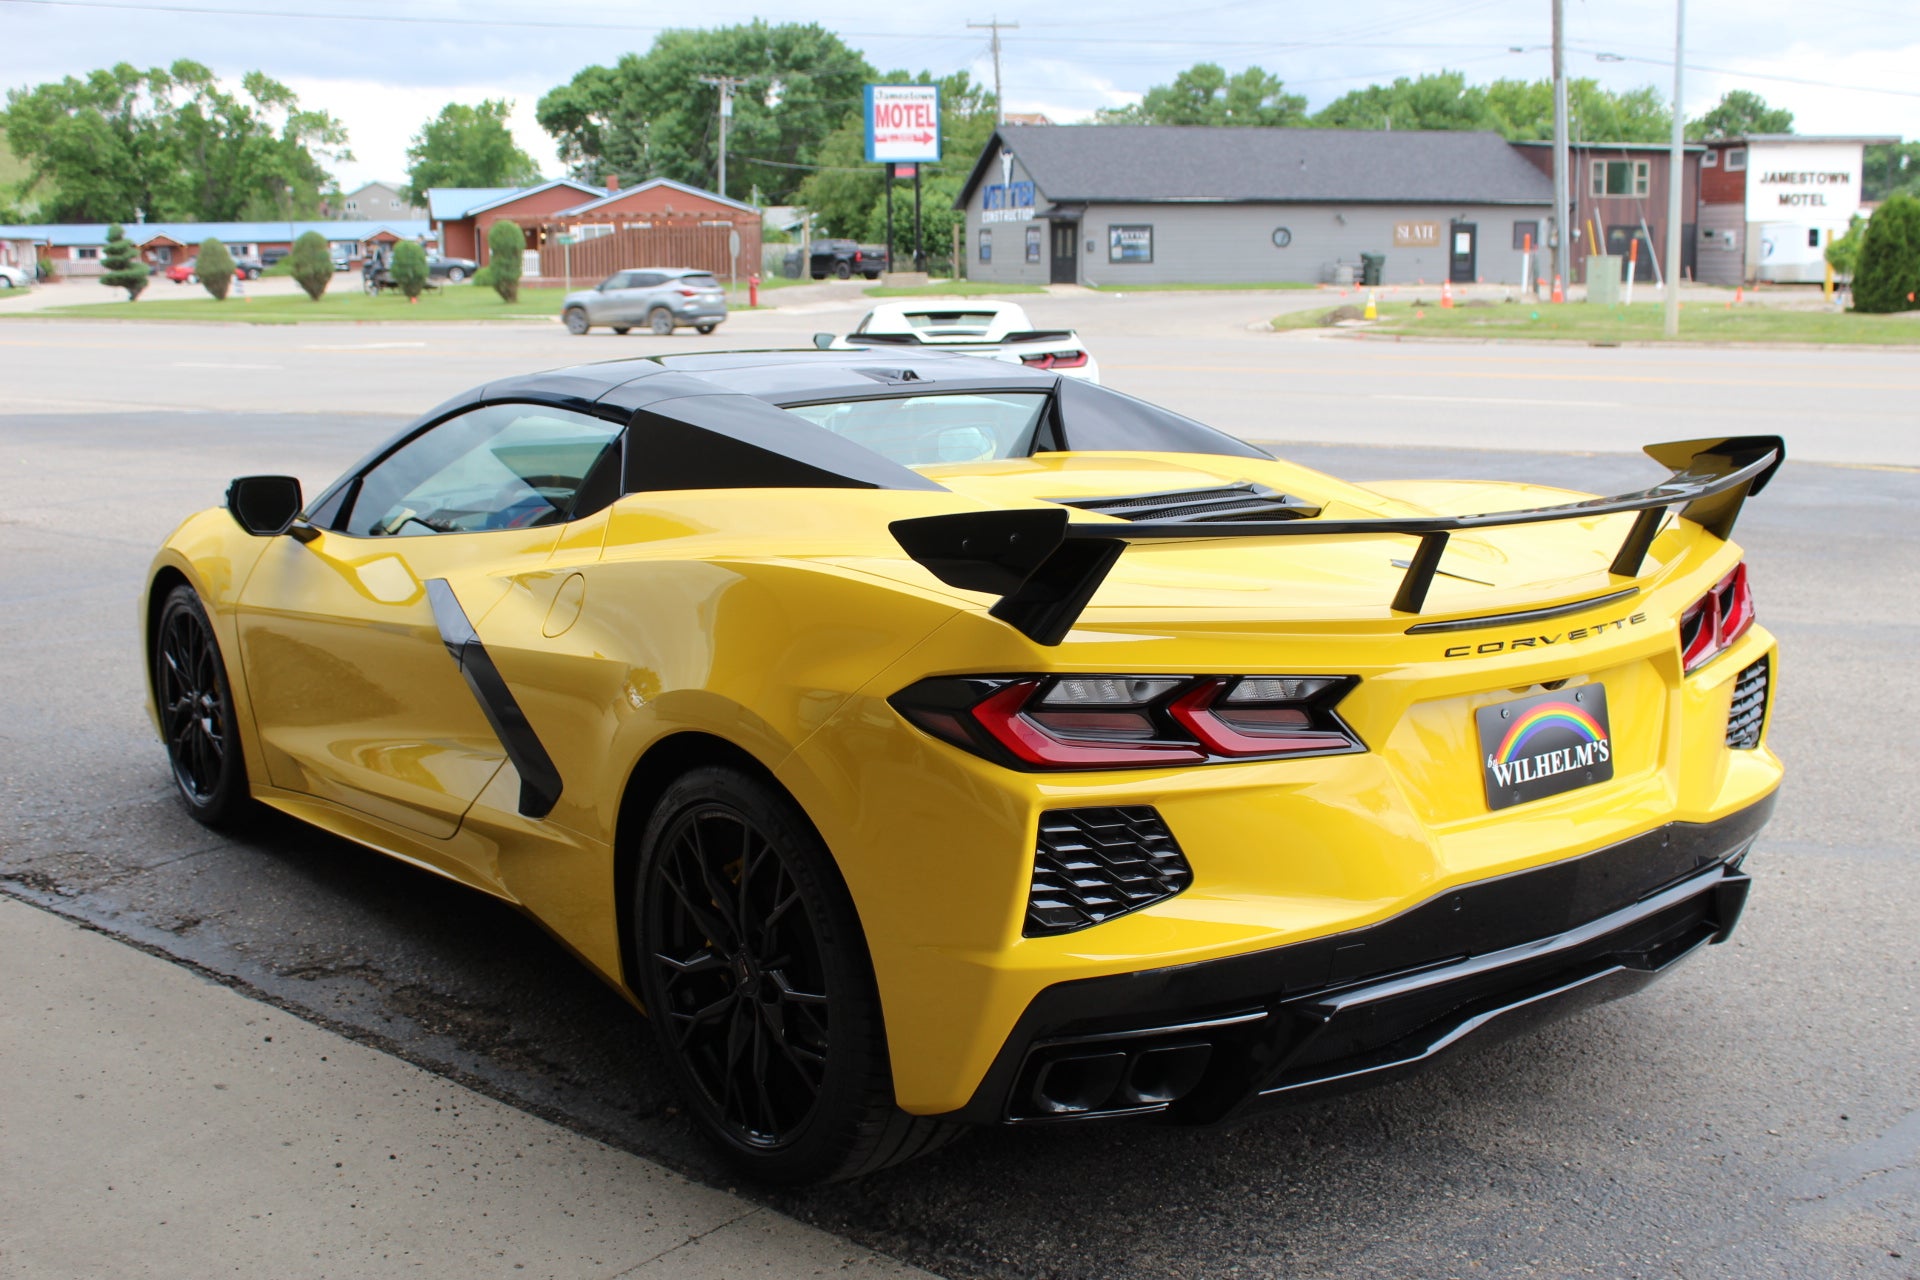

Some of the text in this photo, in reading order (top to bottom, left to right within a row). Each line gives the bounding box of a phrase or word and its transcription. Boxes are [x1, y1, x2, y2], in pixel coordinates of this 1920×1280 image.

[875, 103, 936, 128] MOTEL
[1760, 172, 1850, 184] JAMESTOWN
[982, 181, 1036, 209] VETTER
[1779, 193, 1827, 206] MOTEL
[1444, 612, 1647, 658] CORVETTE
[1492, 739, 1610, 787] WILHELM'S
